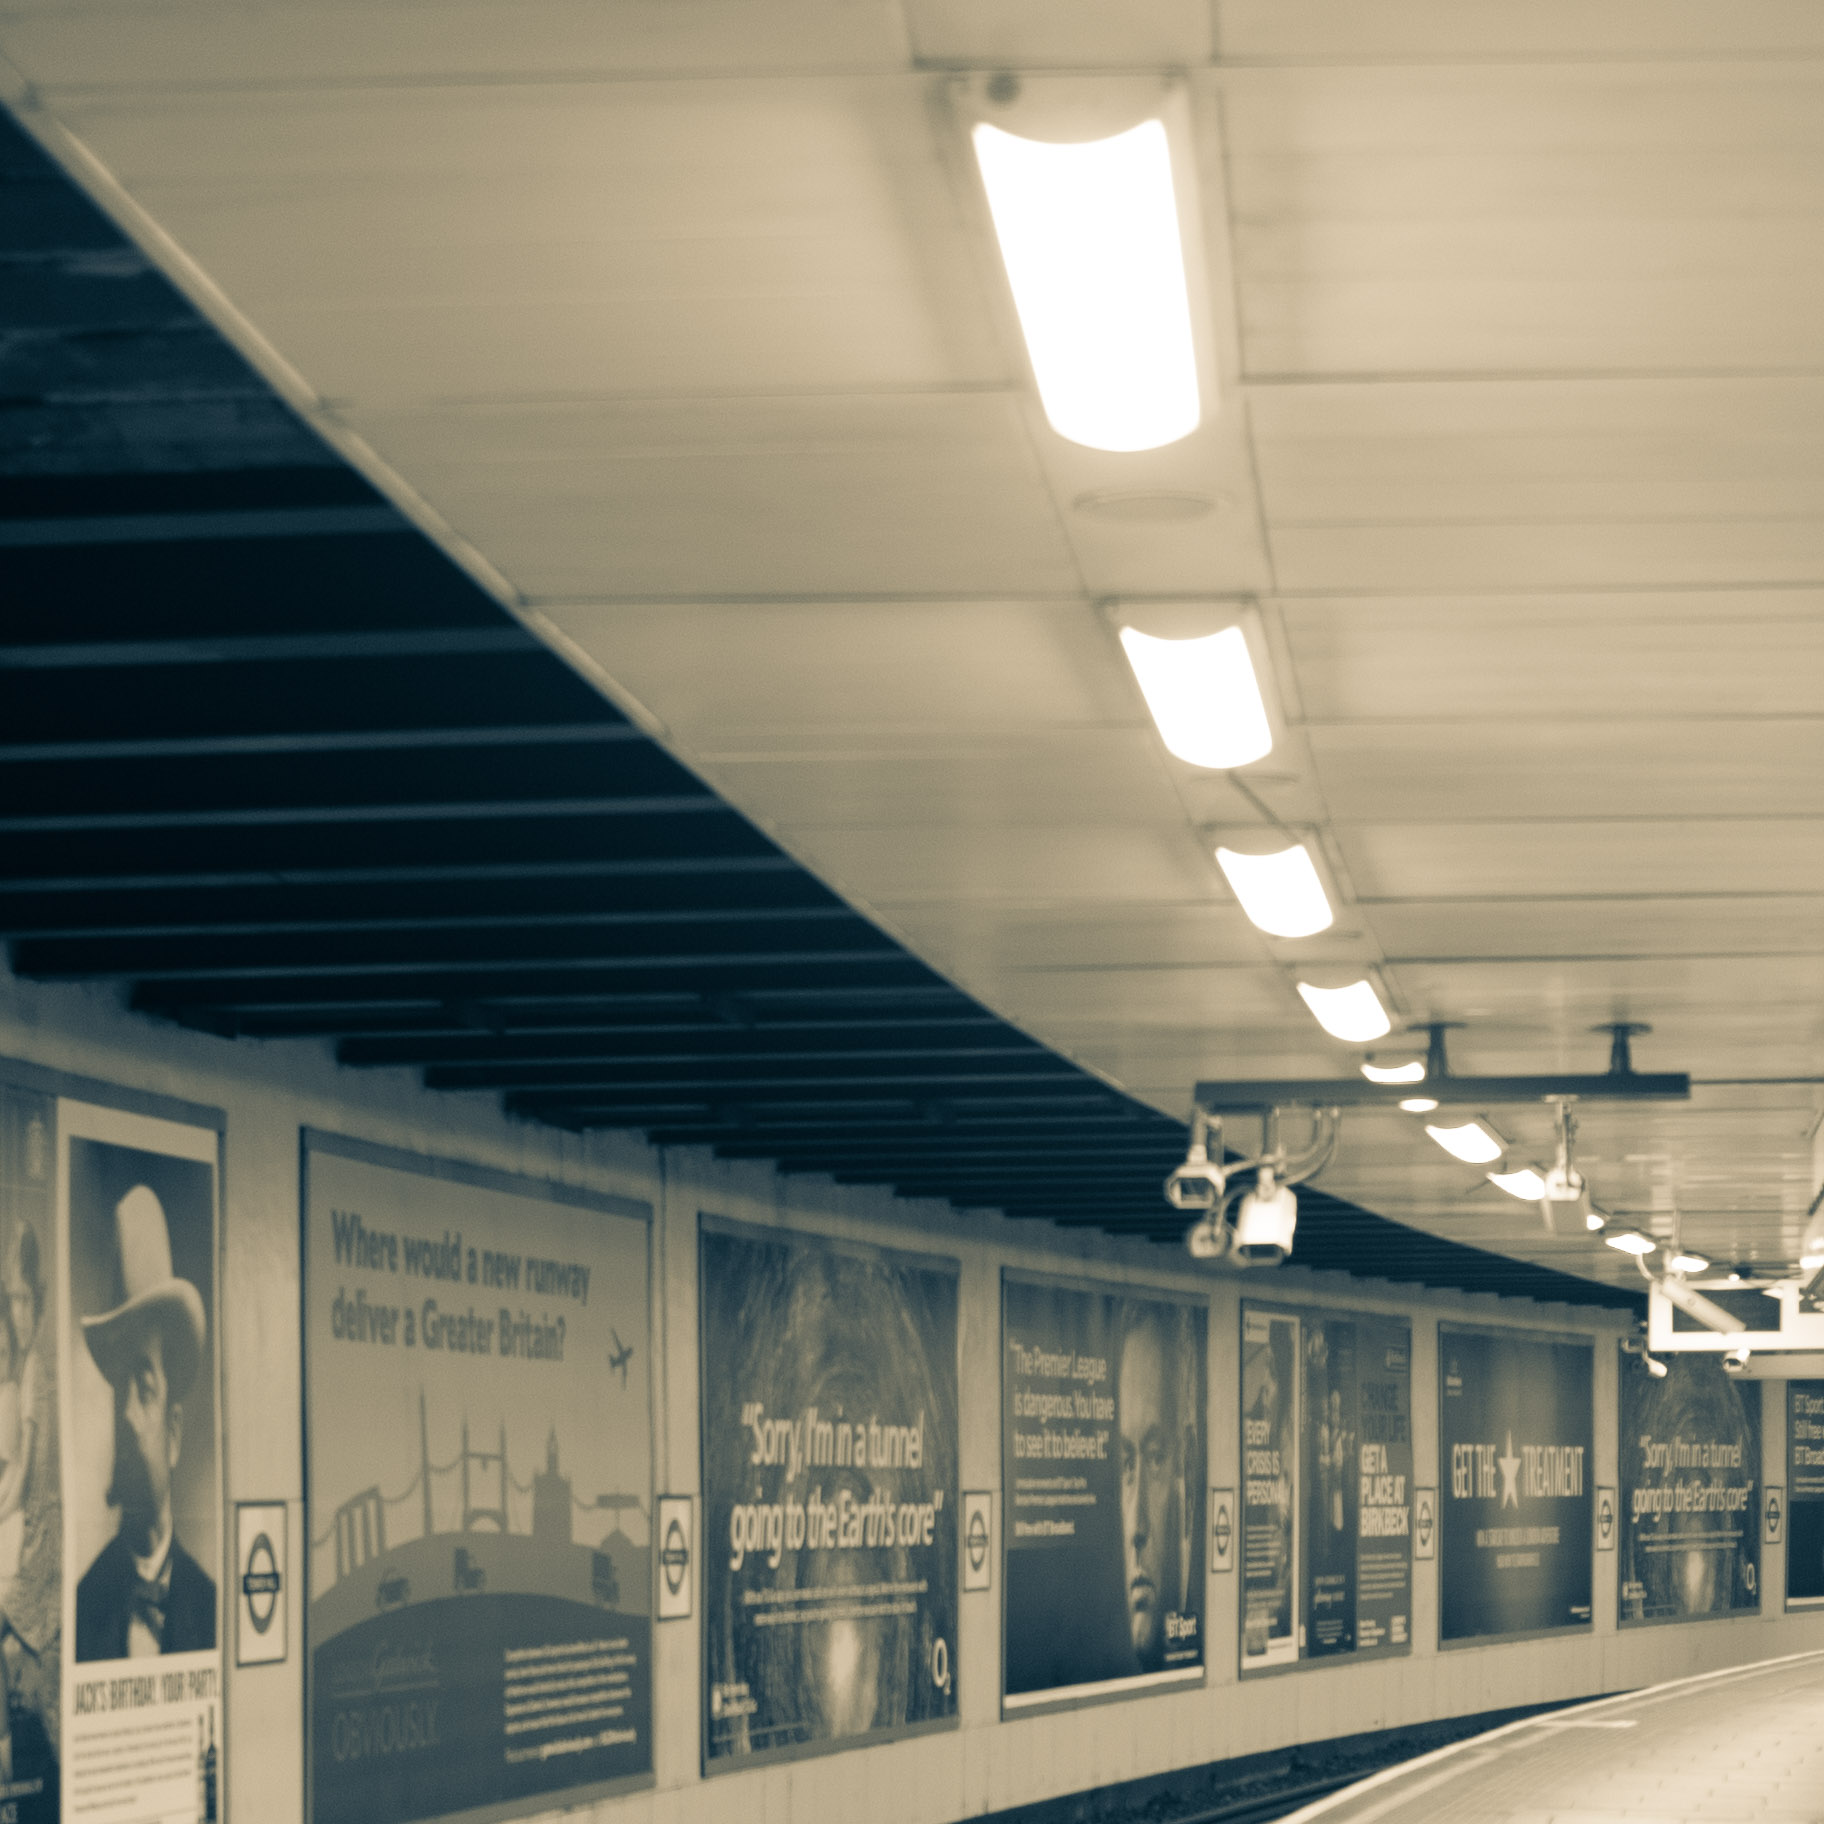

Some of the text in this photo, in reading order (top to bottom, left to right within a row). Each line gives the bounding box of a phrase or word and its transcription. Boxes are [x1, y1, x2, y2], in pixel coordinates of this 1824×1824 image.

[331, 1209, 591, 1307] Where would a new runway
[332, 1286, 566, 1362] deliver a Greater Britain?
[1034, 1345, 1071, 1378] Premier
[1072, 1350, 1106, 1387] League
[1015, 1387, 1023, 1417] is
[1072, 1390, 1091, 1419] You
[1092, 1389, 1114, 1420] have
[1794, 1394, 1806, 1414] BT
[806, 1406, 834, 1466] I'm
[836, 1404, 852, 1466] in
[856, 1423, 866, 1468] a
[869, 1408, 924, 1469] tunnel
[1015, 1430, 1025, 1458] to
[1026, 1434, 1043, 1458] see
[1044, 1429, 1051, 1458] it
[1052, 1430, 1063, 1458] to
[1064, 1429, 1096, 1458] believe
[1247, 1420, 1272, 1445] EVERY
[1247, 1450, 1280, 1475] CRISIS IS
[1361, 1445, 1388, 1474] GET A
[1691, 1434, 1701, 1468] in
[1703, 1444, 1709, 1468] a
[1711, 1435, 1743, 1469] tunnel
[1794, 1446, 1806, 1465] BT
[1454, 1442, 1584, 1499] GET THE TREATMENT
[1247, 1479, 1289, 1505] PERSONAL
[1361, 1475, 1406, 1504] PLACE AT
[1632, 1479, 1661, 1523] going
[1663, 1483, 1674, 1512] to
[1675, 1478, 1691, 1512] the
[1692, 1479, 1725, 1512] Earth's
[729, 1485, 783, 1572] going
[785, 1494, 805, 1550] to
[807, 1485, 836, 1550] the
[837, 1487, 895, 1550] Earth's
[1361, 1506, 1409, 1537] BIRKBECK
